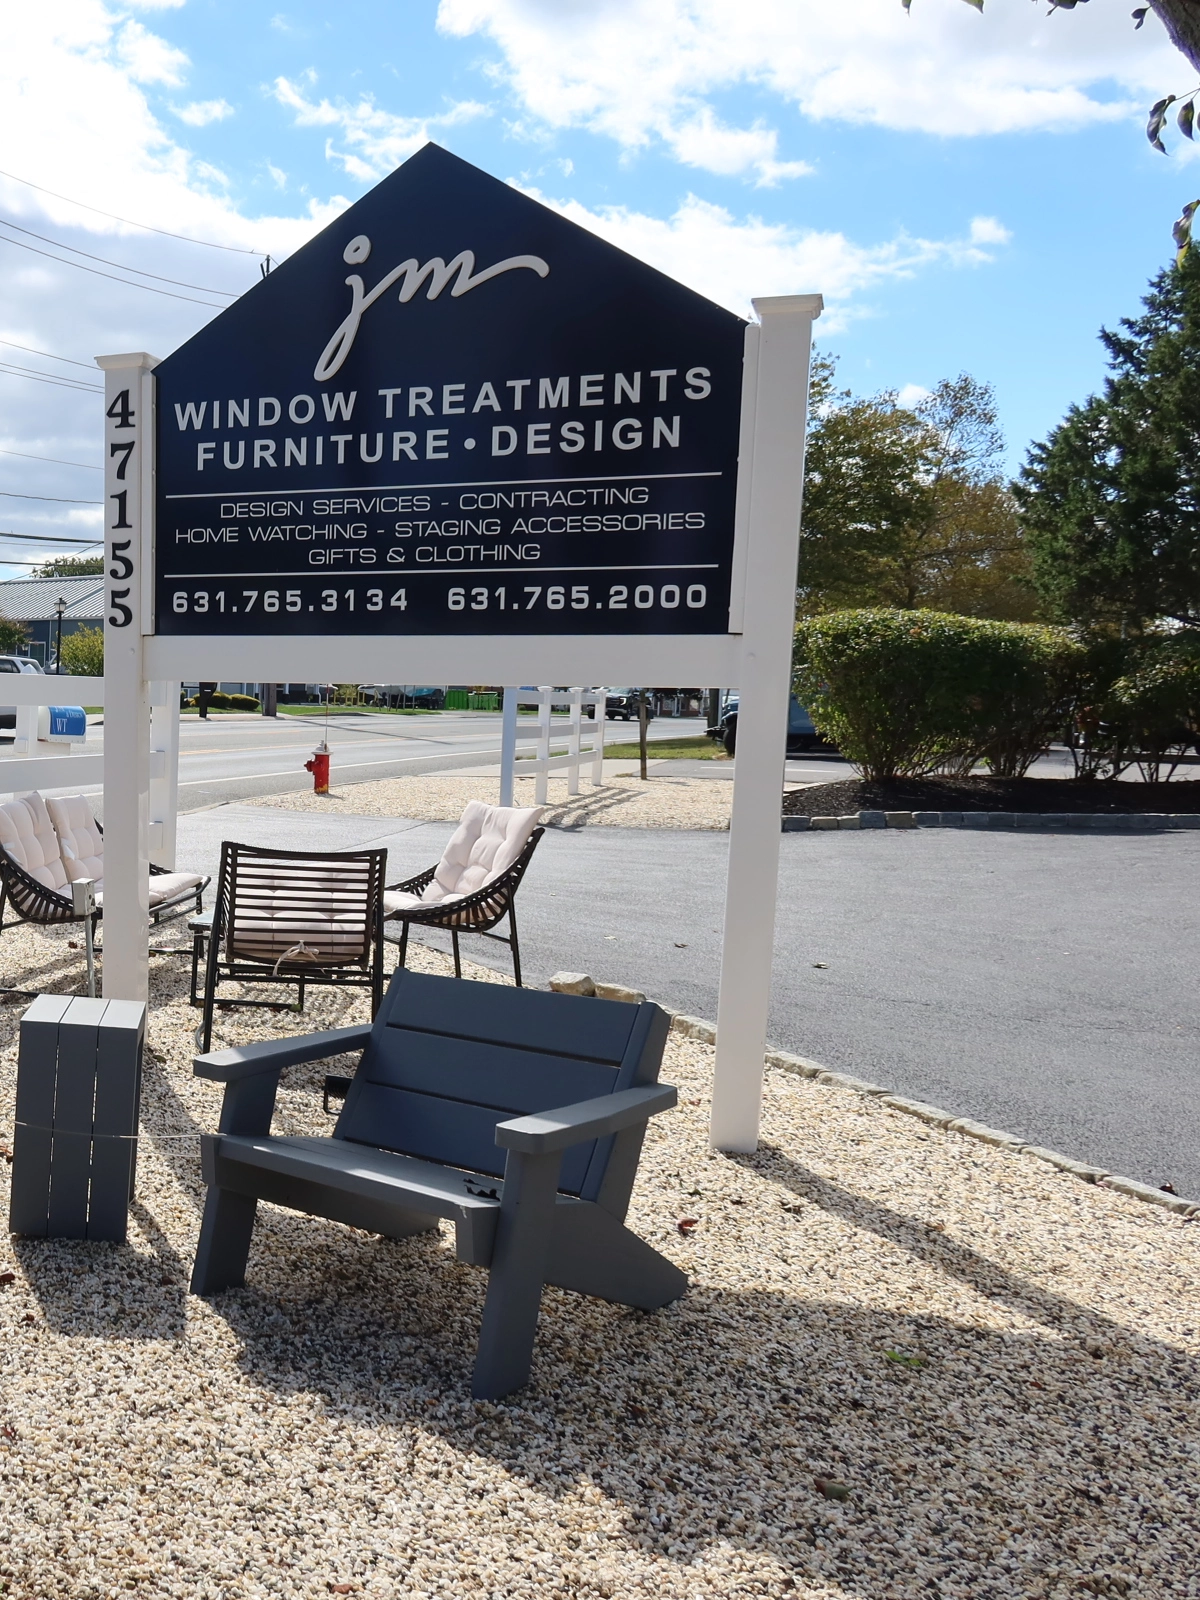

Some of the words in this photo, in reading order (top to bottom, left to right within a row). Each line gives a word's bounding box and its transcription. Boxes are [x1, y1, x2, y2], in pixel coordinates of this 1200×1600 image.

[313, 234, 550, 382] jm
[174, 390, 359, 431] WINDOW
[378, 366, 712, 419] TREATMENTS
[197, 428, 449, 471] FURNITURE
[491, 415, 681, 457] DESIGN
[105, 388, 136, 628] 47155
[220, 499, 304, 519] DESIGN
[312, 495, 431, 516] SERVICES
[459, 486, 649, 510] CONTRACTING
[175, 526, 239, 544] HOME
[247, 523, 368, 542] WATCHING
[395, 517, 501, 538] STAGING
[510, 512, 706, 535] ACCESSORIES
[308, 548, 377, 566] GIFTS
[386, 547, 406, 563] &
[415, 543, 541, 563] CLOTHING
[172, 588, 408, 614] 631.765.3134
[447, 584, 707, 611] 631.765.2000
